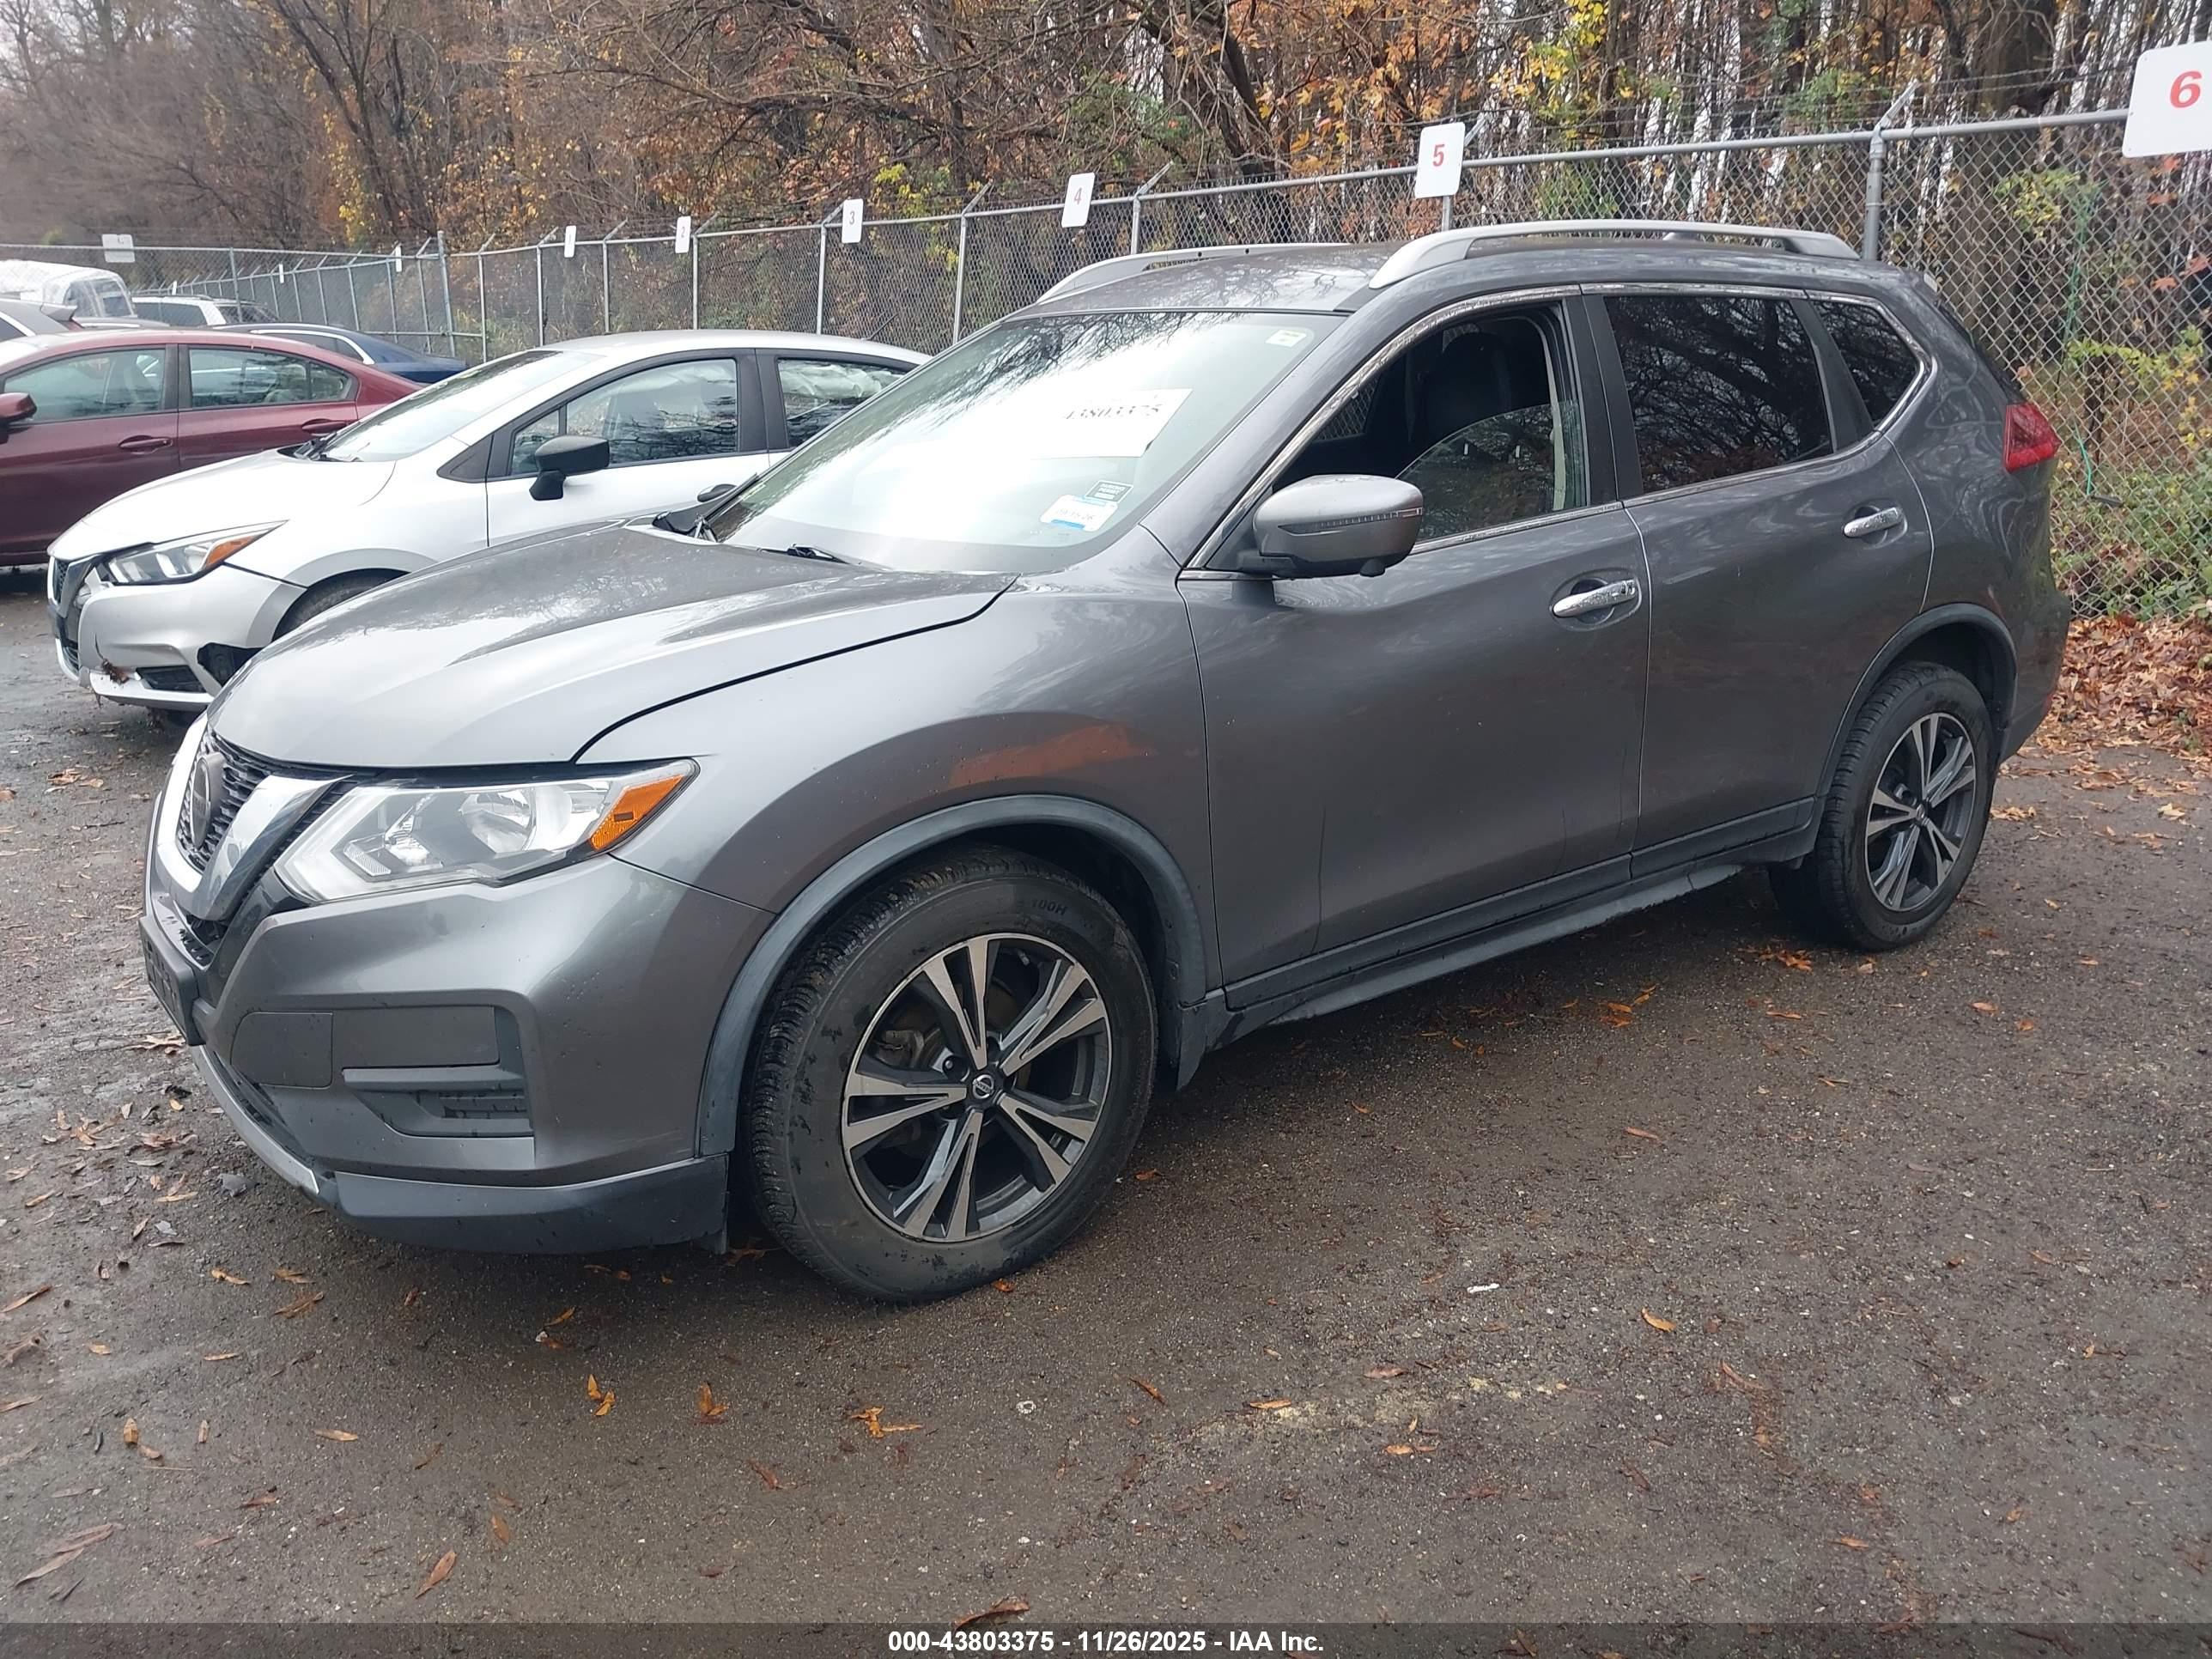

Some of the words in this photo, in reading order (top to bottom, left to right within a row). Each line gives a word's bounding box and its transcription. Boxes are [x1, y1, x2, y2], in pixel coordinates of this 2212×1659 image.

[2170, 70, 2203, 108] 6
[1432, 143, 1445, 167] 5
[1073, 187, 1083, 205] 4
[848, 210, 855, 225] 3
[1031, 900, 1068, 915] 100H
